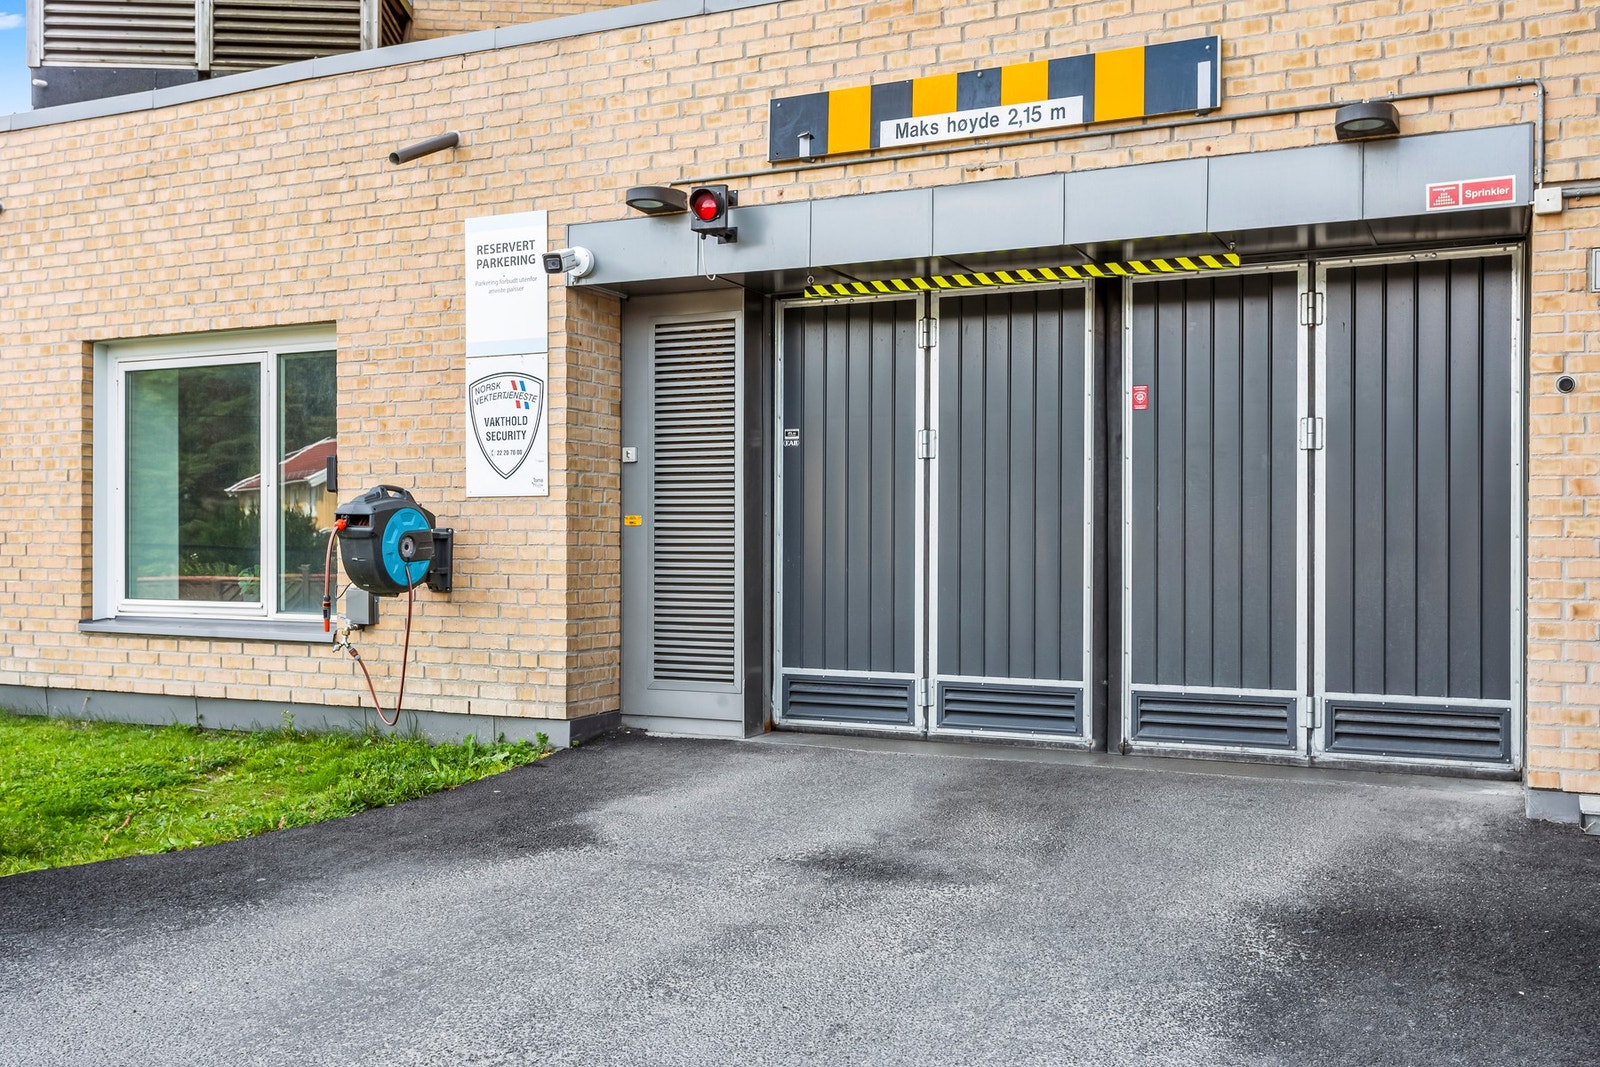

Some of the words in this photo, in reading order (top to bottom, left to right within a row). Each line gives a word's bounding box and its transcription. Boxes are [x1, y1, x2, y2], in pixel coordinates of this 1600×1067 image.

[895, 121, 940, 140] Maks
[947, 112, 1000, 133] høyde
[1007, 105, 1042, 128] 2,15
[1050, 104, 1066, 121] m
[1464, 186, 1510, 200] Sprinkler
[476, 239, 536, 256] RESERVERT
[476, 254, 536, 270] PARKERING
[474, 382, 501, 395] NORSK
[474, 390, 538, 406] VEKTERTJENESTE
[483, 415, 528, 427] VAKTHOLD
[485, 430, 527, 442] SECURITY
